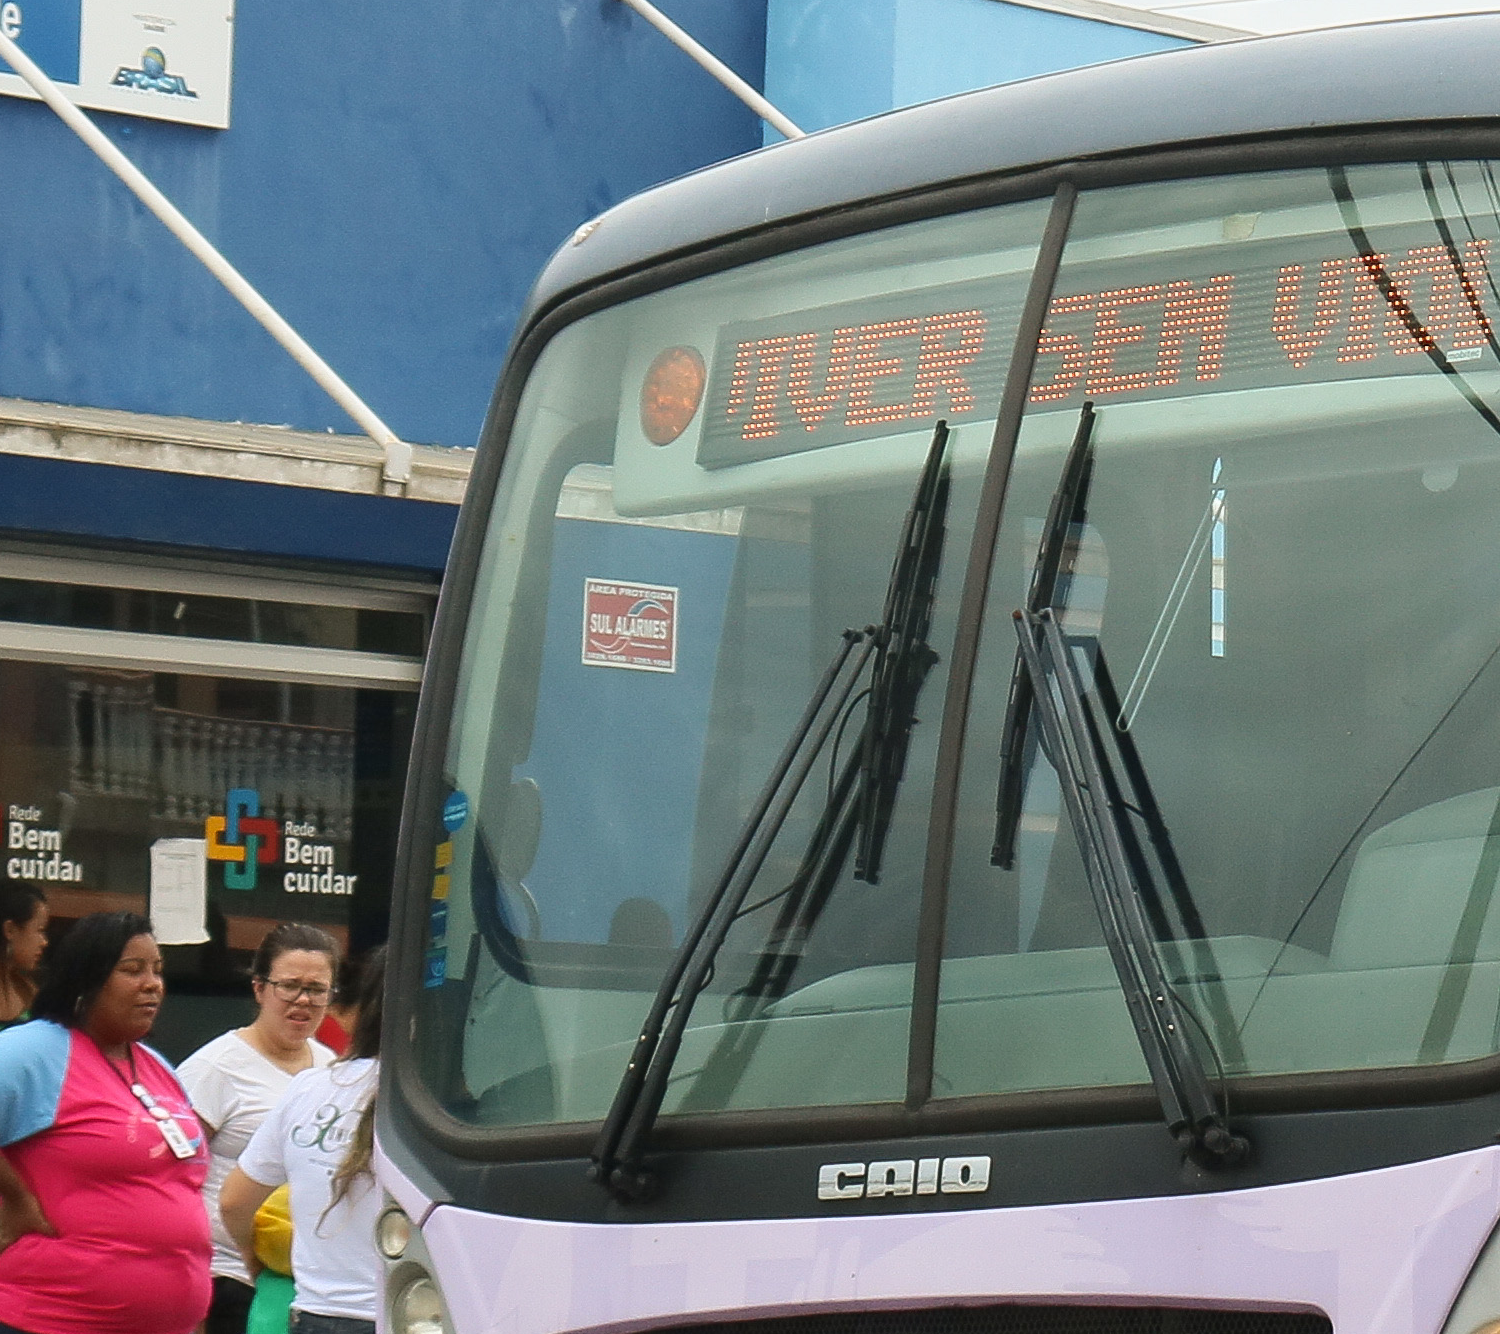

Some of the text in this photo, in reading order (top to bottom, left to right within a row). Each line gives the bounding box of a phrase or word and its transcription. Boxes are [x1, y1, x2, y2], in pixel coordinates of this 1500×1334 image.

[1030, 273, 1236, 403] SEM
[589, 613, 667, 640] SUL ALARMES
[8, 804, 42, 821] Rede
[8, 821, 62, 851] Bem
[284, 821, 317, 838] Rede
[284, 837, 334, 865] Bem
[283, 866, 358, 895] cuidar
[817, 1156, 991, 1200] CAIO
